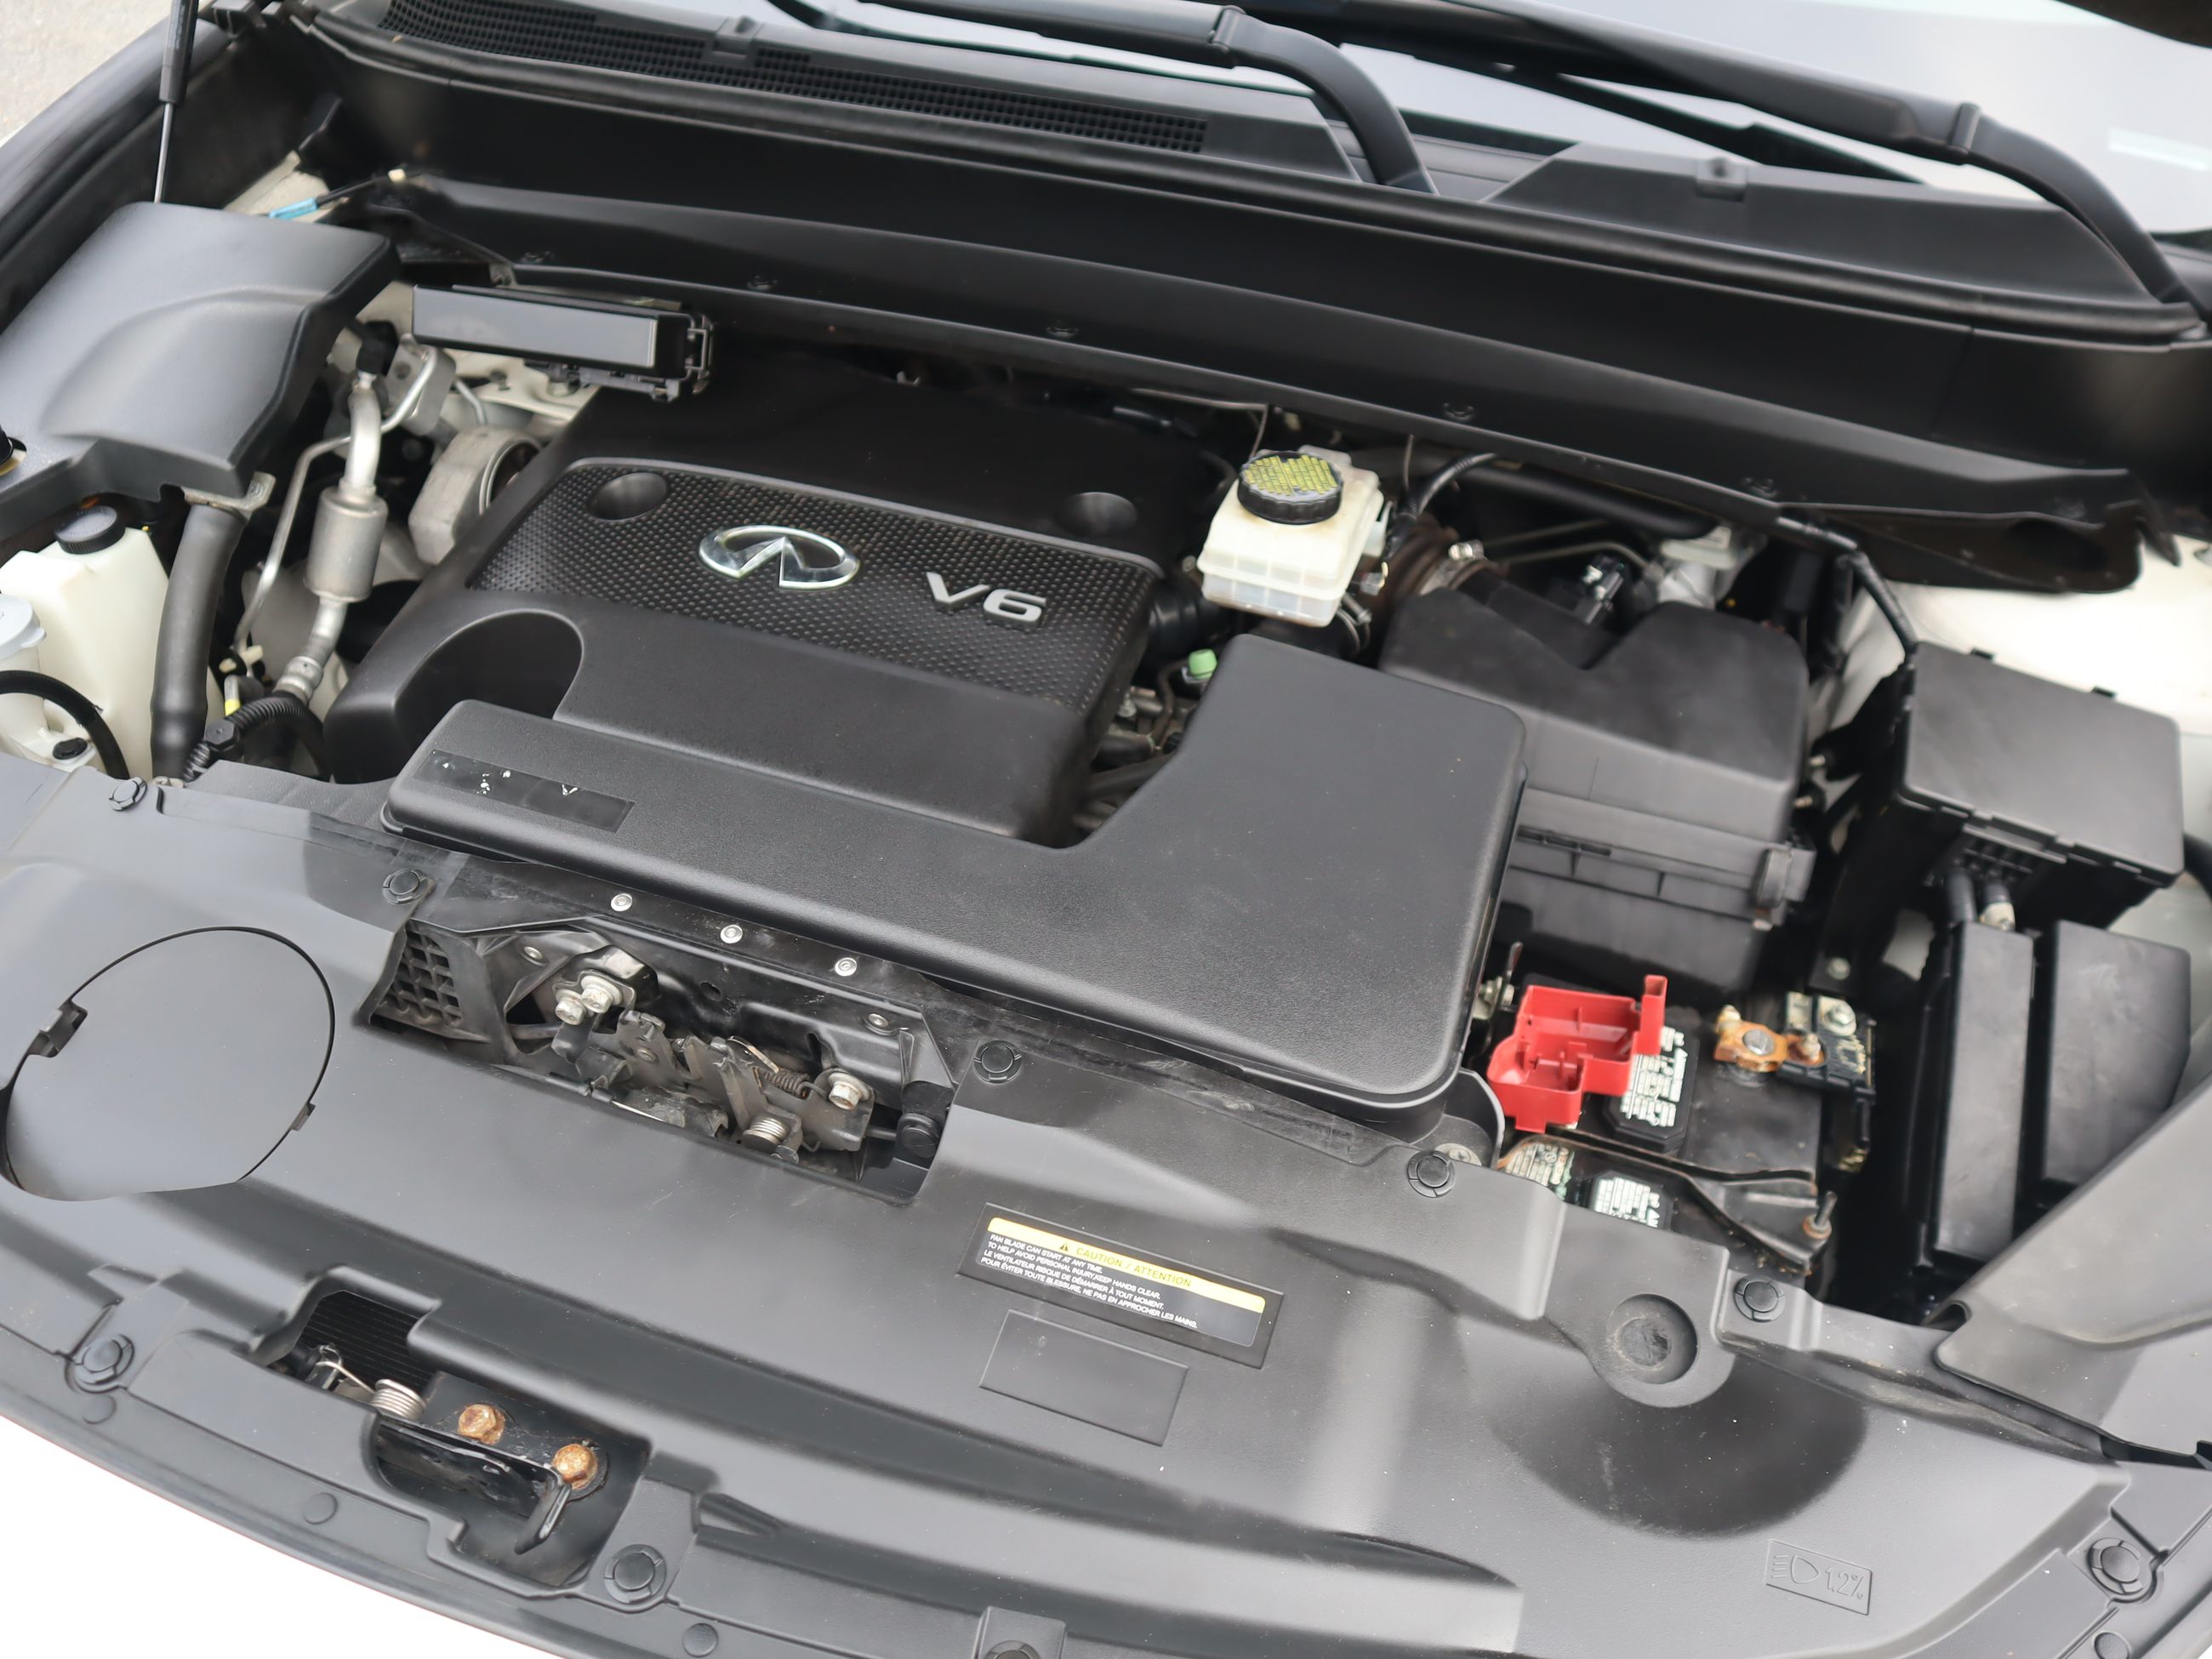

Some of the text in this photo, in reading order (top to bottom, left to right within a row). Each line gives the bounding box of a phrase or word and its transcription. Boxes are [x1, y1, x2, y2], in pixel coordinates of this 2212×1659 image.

[926, 572, 1046, 623] V6
[989, 1234, 1103, 1274] FAN BLADE CAN START AT ANY TIME.
[997, 1244, 1015, 1255] HELP
[1014, 1249, 1035, 1261] AVOID
[1035, 1255, 1071, 1272] PERSONAL
[1113, 1279, 1137, 1293] HANDS
[1137, 1287, 1160, 1300] CLEAR.
[1075, 1247, 1123, 1267] CAUTION
[1133, 1265, 1192, 1287] ATTENTION
[980, 1257, 1001, 1268] POUR
[1001, 1261, 1023, 1275] ÉVITER
[1023, 1270, 1046, 1282] TOUTE
[1082, 1287, 1093, 1297] NE
[1093, 1291, 1107, 1301] PAS
[1108, 1296, 1118, 1304] EN
[1117, 1298, 1160, 1318] APPROCHER
[1160, 1311, 1175, 1321] LES
[1175, 1314, 1199, 1329] MAINS.
[993, 1252, 1035, 1270] VENTILATEUR
[1035, 1264, 1061, 1279] RISQUE
[1061, 1272, 1071, 1281] DE
[1071, 1274, 1109, 1292] DÉMARRER
[1115, 1290, 1134, 1301] TOUT
[1133, 1294, 1165, 1310] MOMENT.
